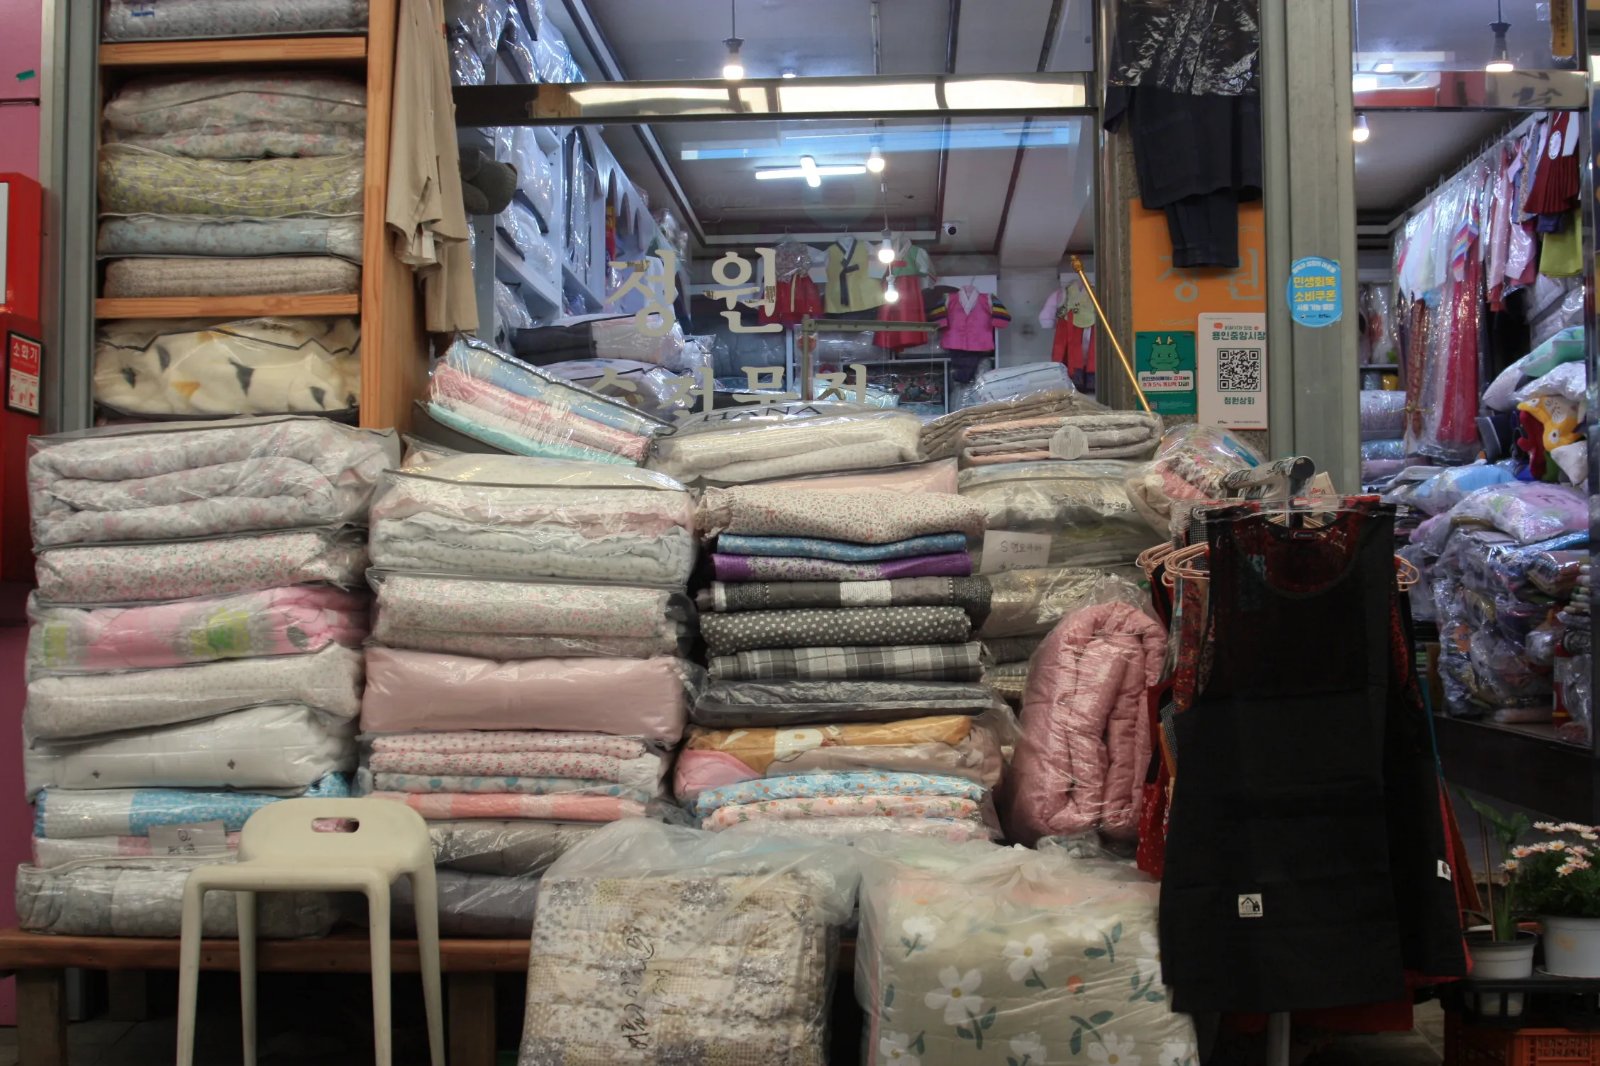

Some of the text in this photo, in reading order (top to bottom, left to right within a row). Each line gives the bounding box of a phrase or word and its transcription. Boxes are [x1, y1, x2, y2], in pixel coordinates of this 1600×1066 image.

[1293, 276, 1336, 288] 민생회복
[607, 248, 784, 337] 정원
[1294, 290, 1336, 302] 소비쿠폰
[1212, 331, 1266, 341] 용인중앙시장
[13, 342, 38, 363] 소화기
[702, 405, 823, 423] HANA
